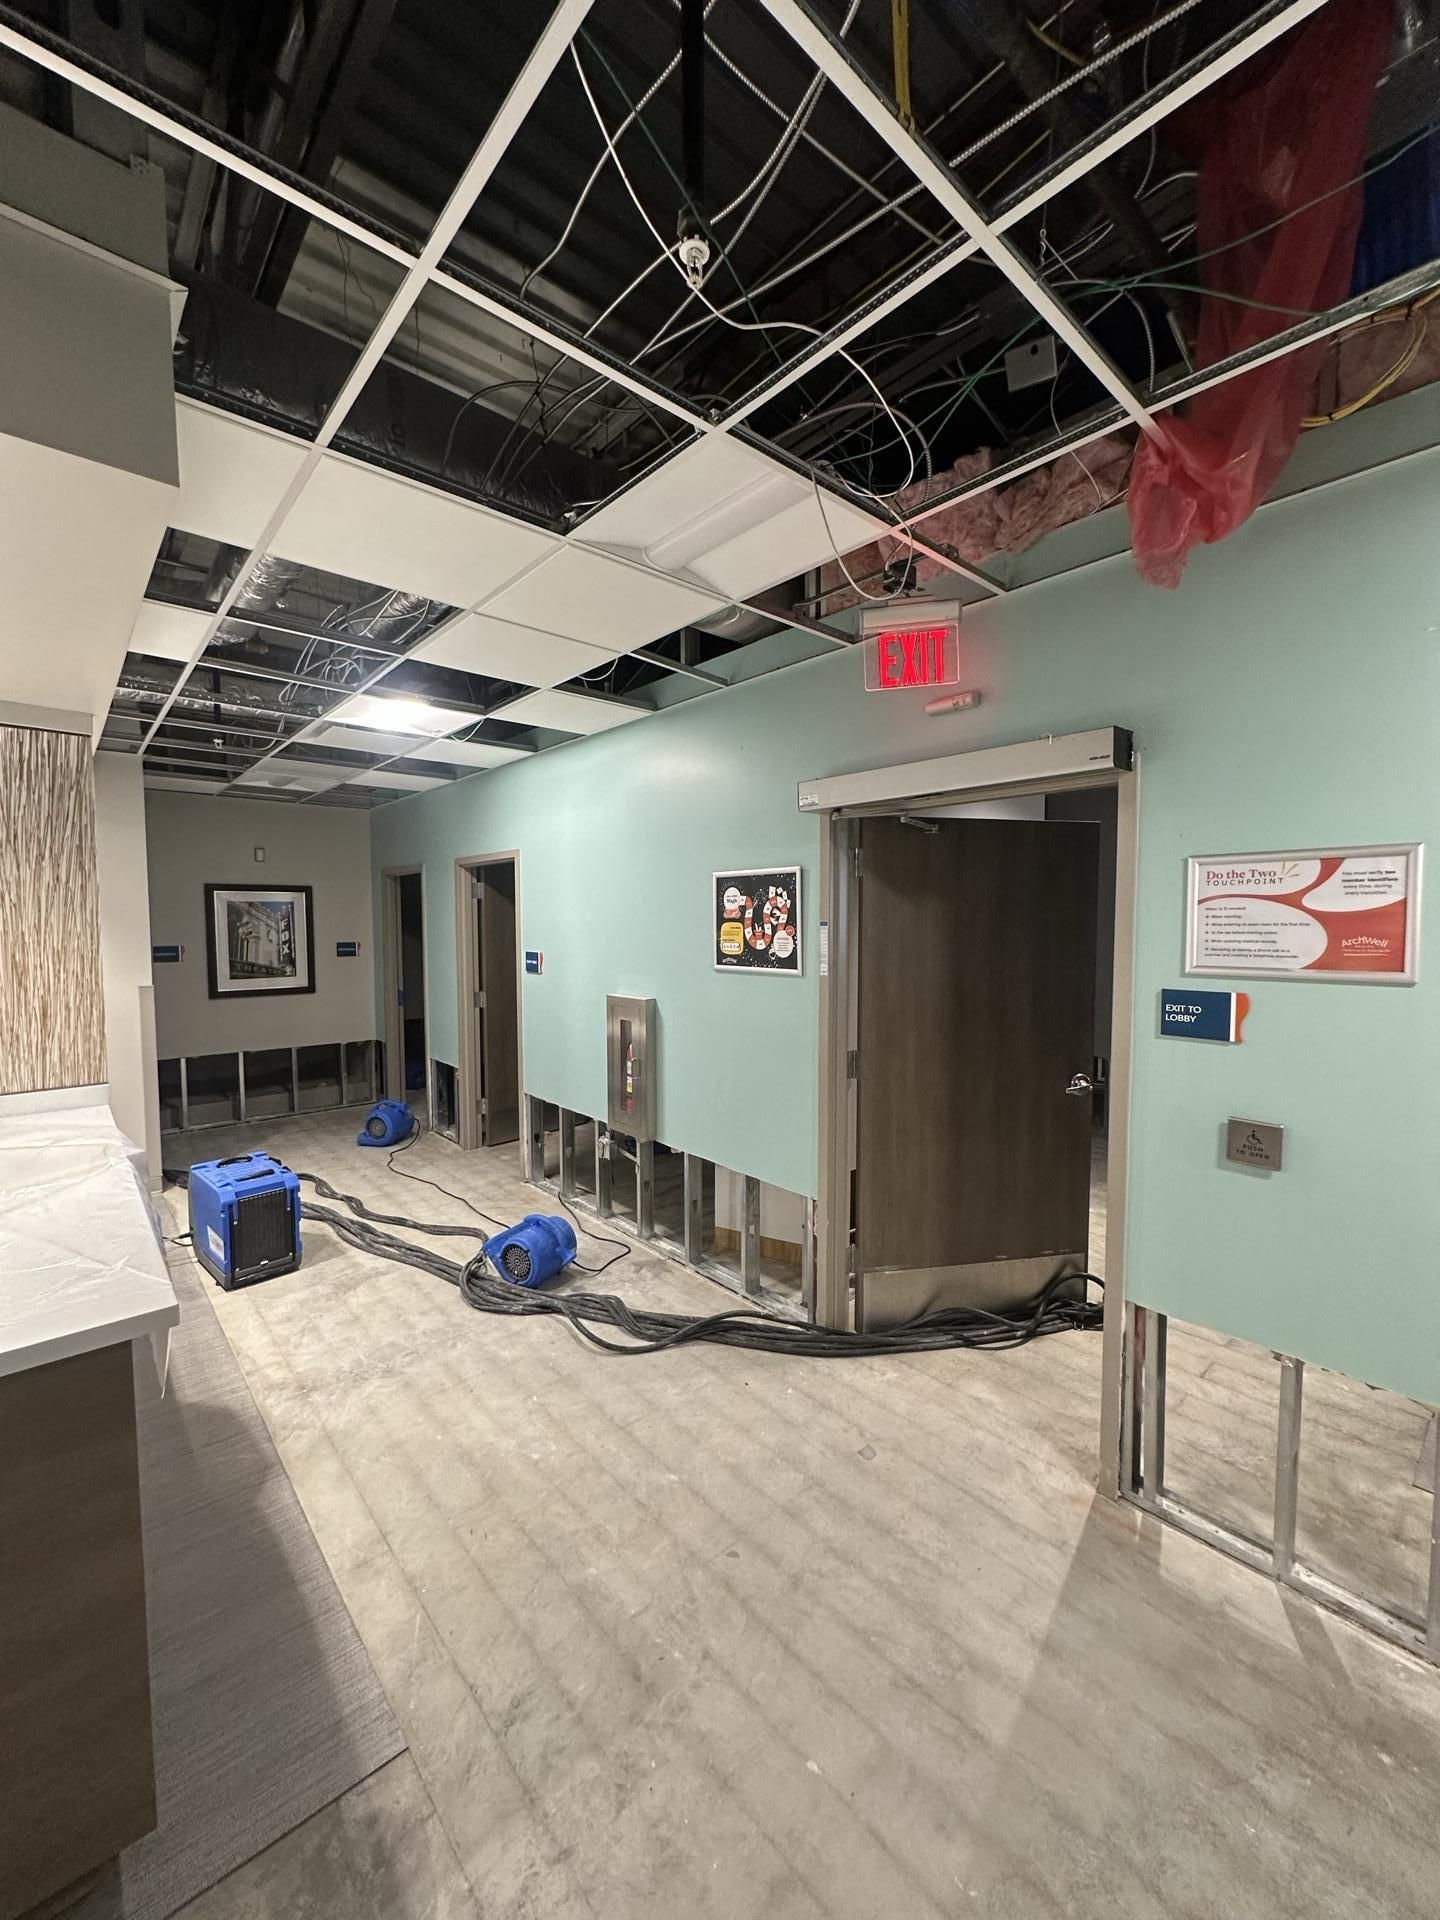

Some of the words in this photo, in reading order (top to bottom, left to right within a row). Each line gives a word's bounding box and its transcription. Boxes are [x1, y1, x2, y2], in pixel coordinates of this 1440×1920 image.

[878, 628, 948, 687] EXIT
[1206, 871, 1223, 880] Do
[1226, 869, 1246, 879] the
[1248, 868, 1276, 878] Two
[1205, 877, 1284, 886] TOUCHPOINT
[281, 918, 290, 955] FOX
[1341, 936, 1389, 947] ArchWell
[1165, 1004, 1186, 1012] EXIT
[1188, 1005, 1202, 1013] TO
[1165, 1013, 1197, 1023] LOBBY
[1243, 1144, 1264, 1152] PUSH
[1249, 1151, 1270, 1160] OPEN
